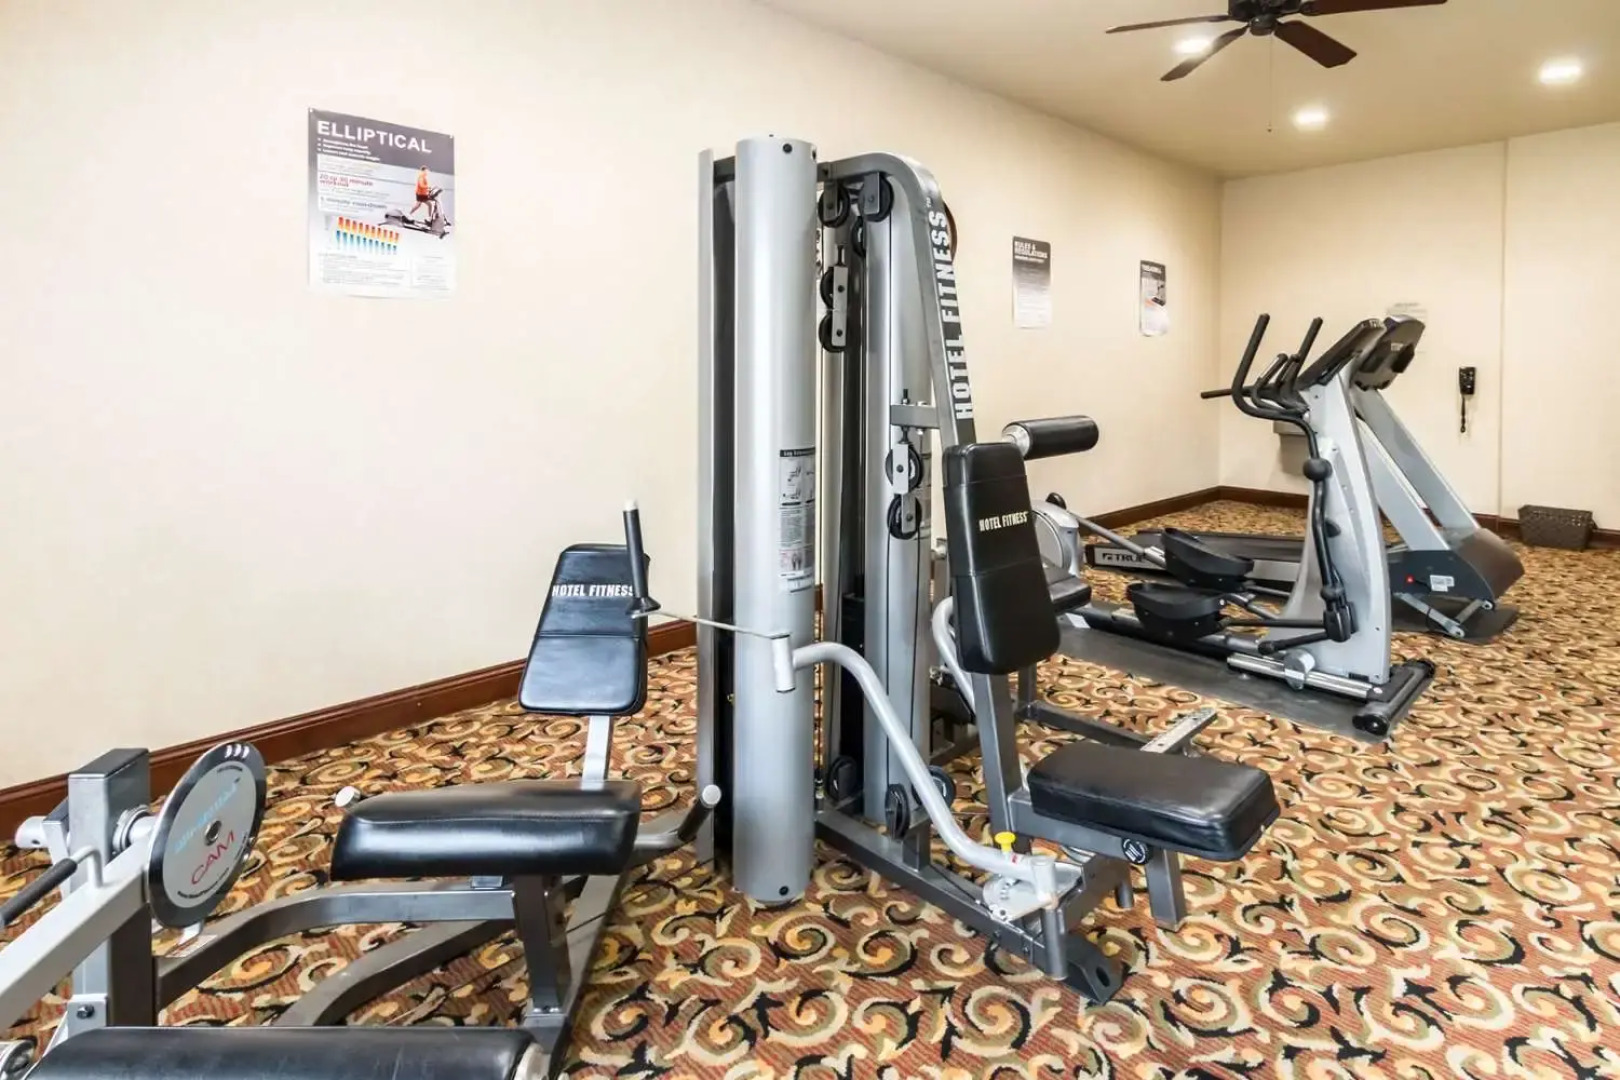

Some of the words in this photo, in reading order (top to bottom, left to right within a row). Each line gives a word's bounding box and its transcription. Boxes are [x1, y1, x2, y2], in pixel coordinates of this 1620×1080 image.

[317, 120, 432, 154] ELLIPTICAL
[929, 210, 960, 324] FITNESS
[946, 334, 973, 419] HOTEL
[979, 516, 1001, 531] HOTEL
[1002, 511, 1027, 527] FITNESS
[552, 584, 586, 597] HOTEL
[191, 830, 235, 885] CAM
